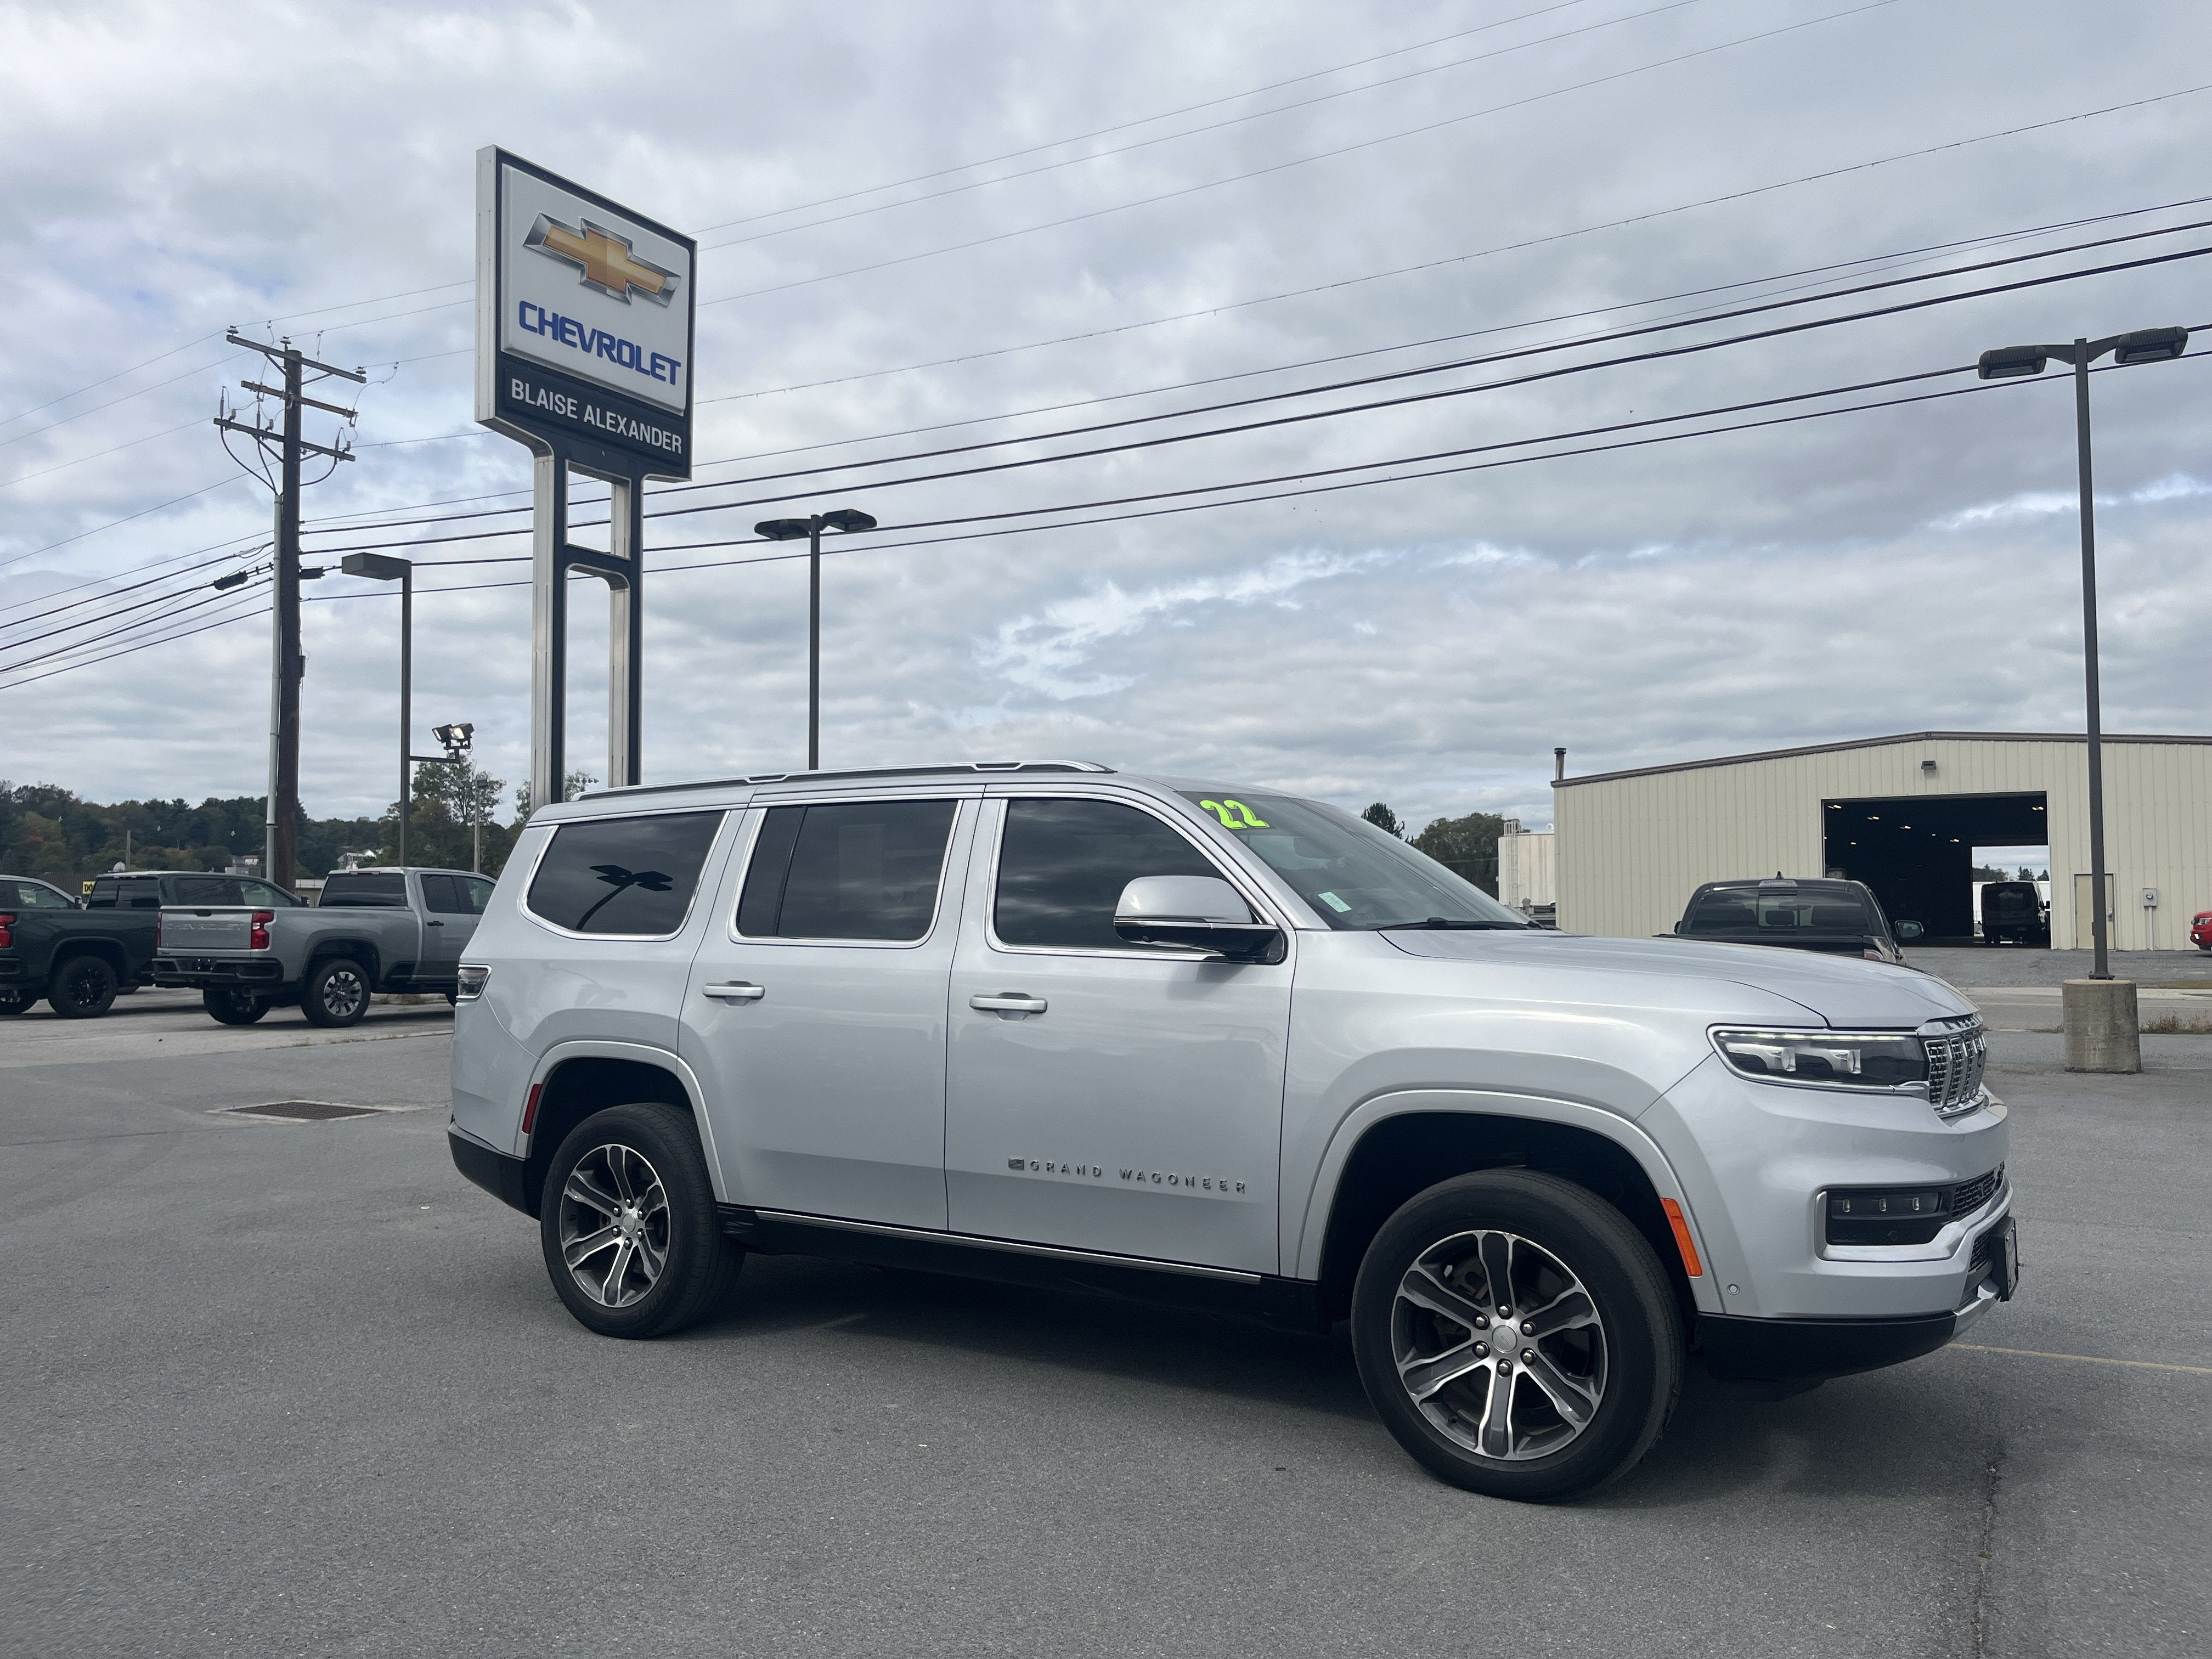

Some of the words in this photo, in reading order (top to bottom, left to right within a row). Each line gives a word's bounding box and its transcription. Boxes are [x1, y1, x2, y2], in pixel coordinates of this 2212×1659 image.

[518, 301, 681, 385] CHEVROLET
[511, 378, 578, 419] BLAISE
[584, 405, 682, 454] ALEXANDER
[1200, 799, 1270, 830] 22
[1030, 1159, 1102, 1177] GRAND
[1119, 1167, 1246, 1194] WAGONEER
